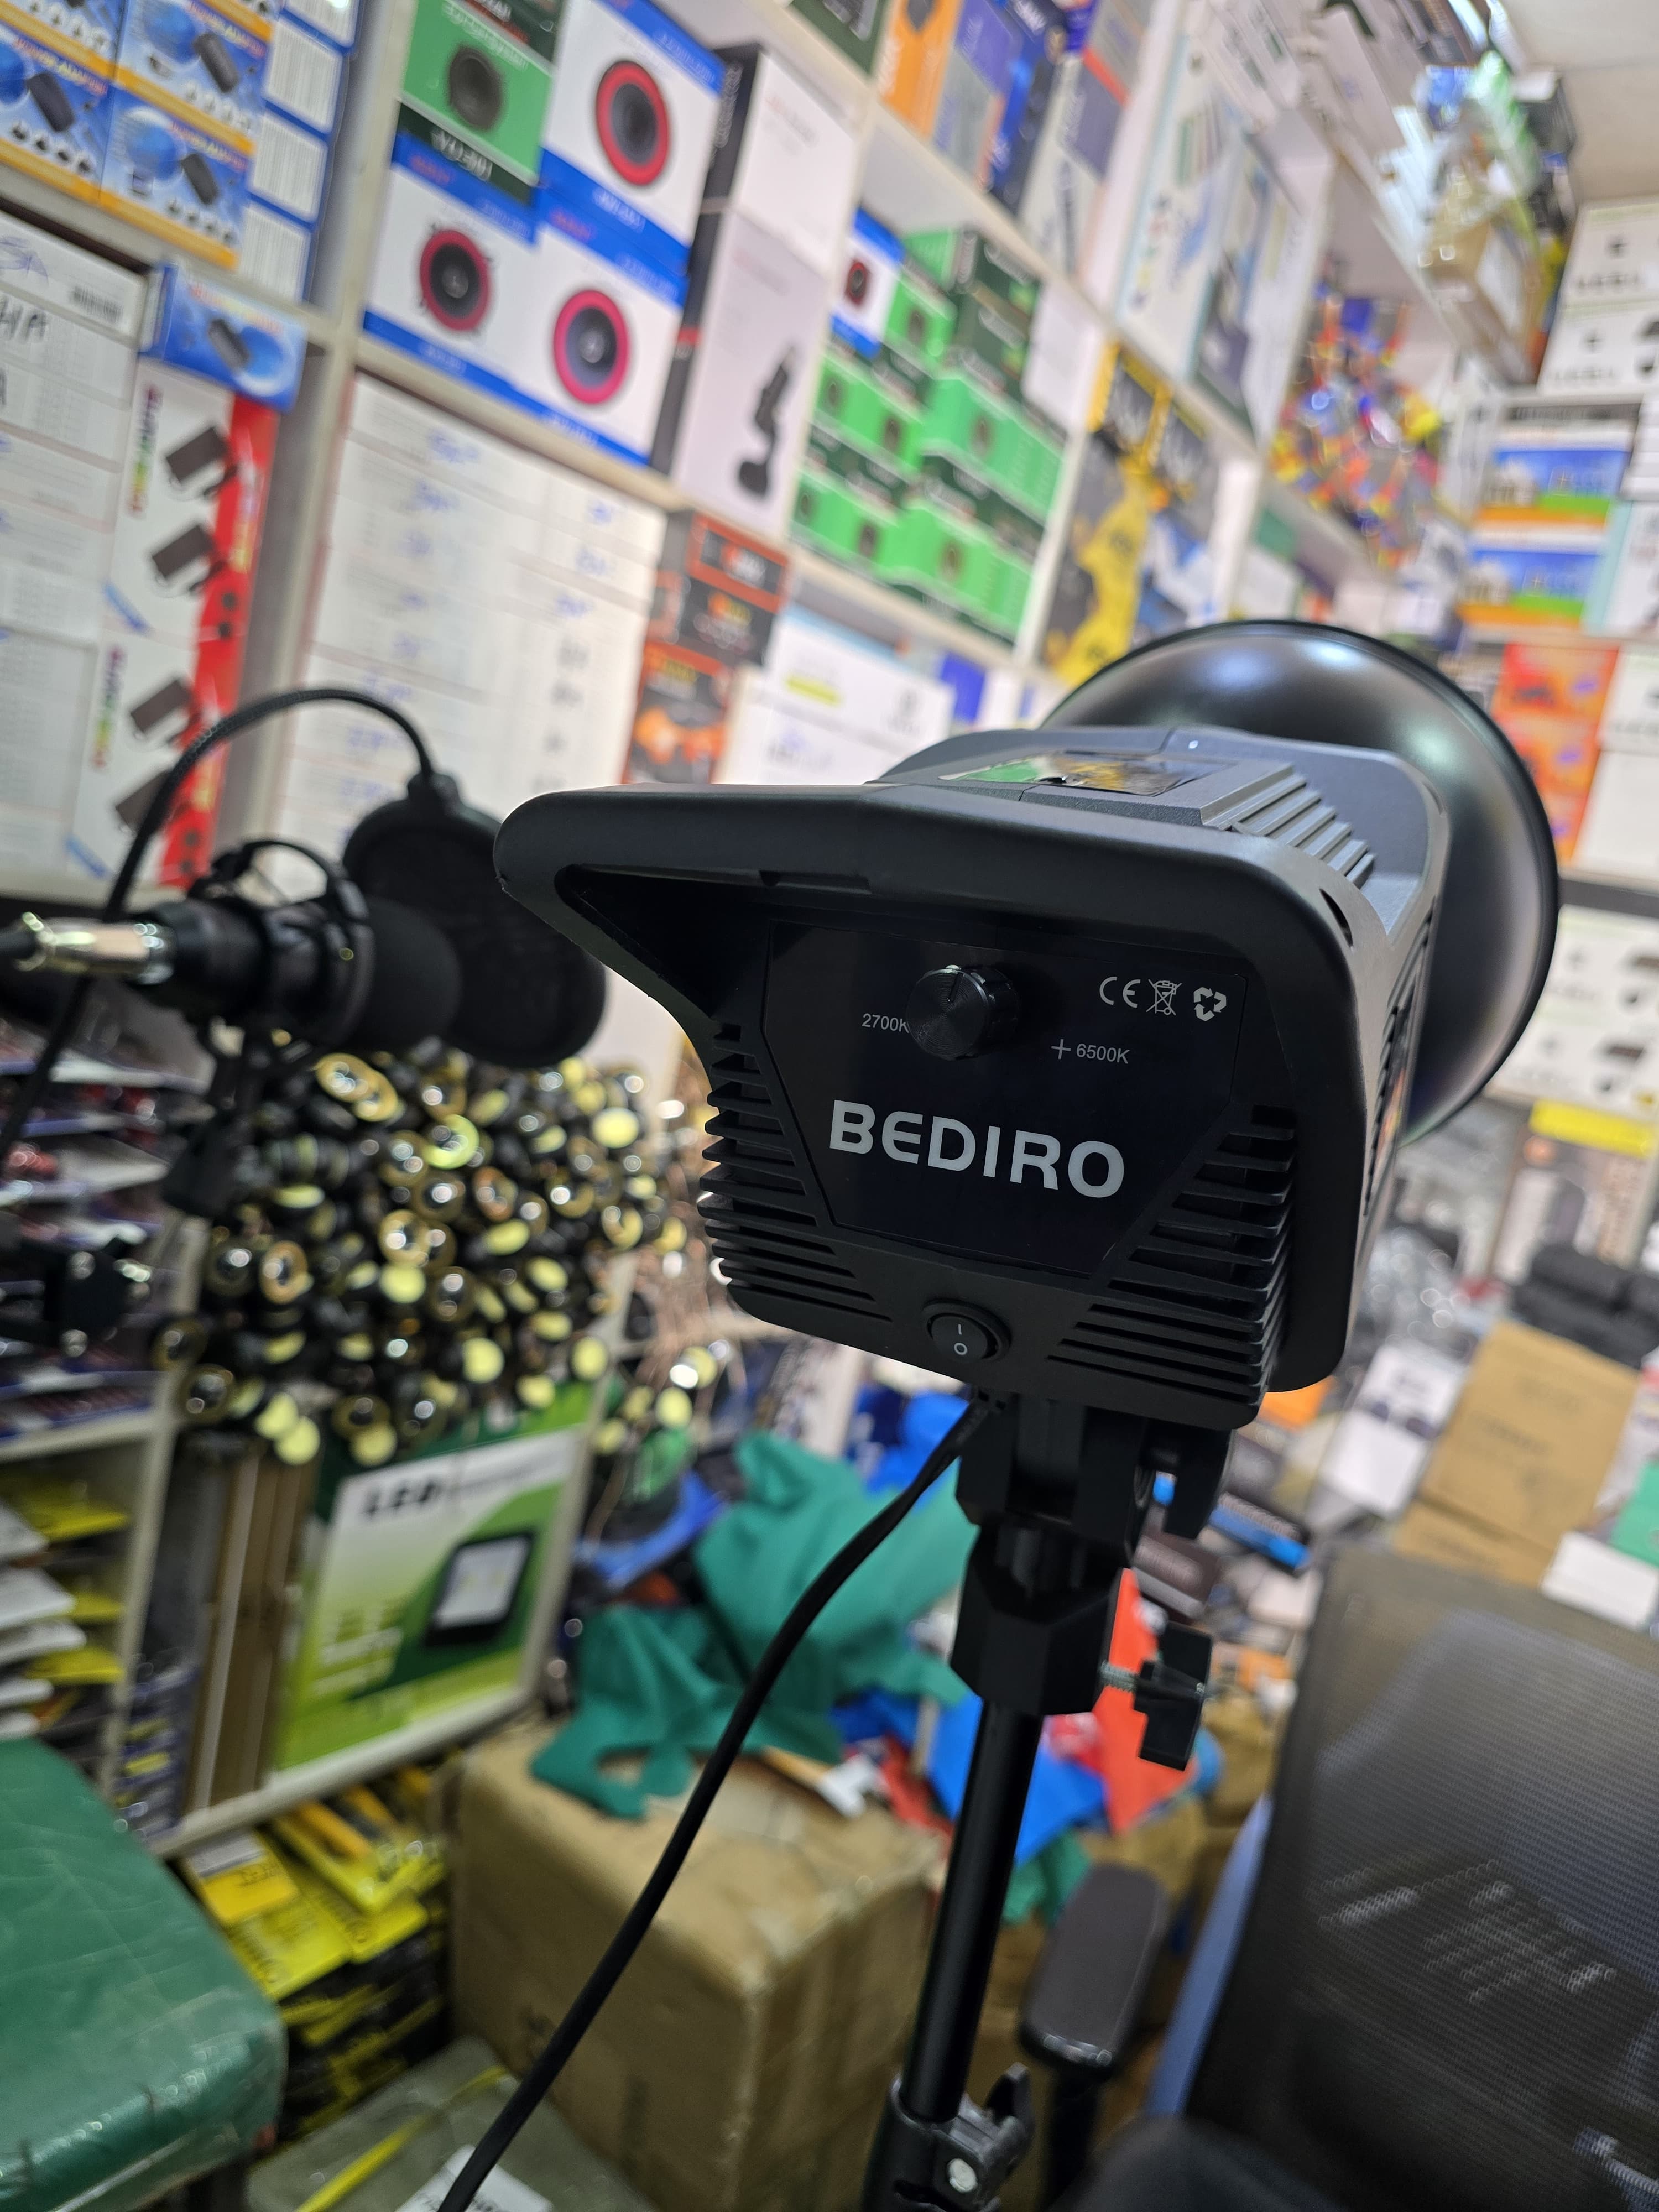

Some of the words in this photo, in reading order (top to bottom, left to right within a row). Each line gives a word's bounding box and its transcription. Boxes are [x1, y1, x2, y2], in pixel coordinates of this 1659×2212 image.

[1099, 976, 1141, 1008] CE
[862, 1013, 910, 1034] 2700K
[1076, 1043, 1130, 1064] 6500K
[830, 1099, 1124, 1198] BEDIRO
